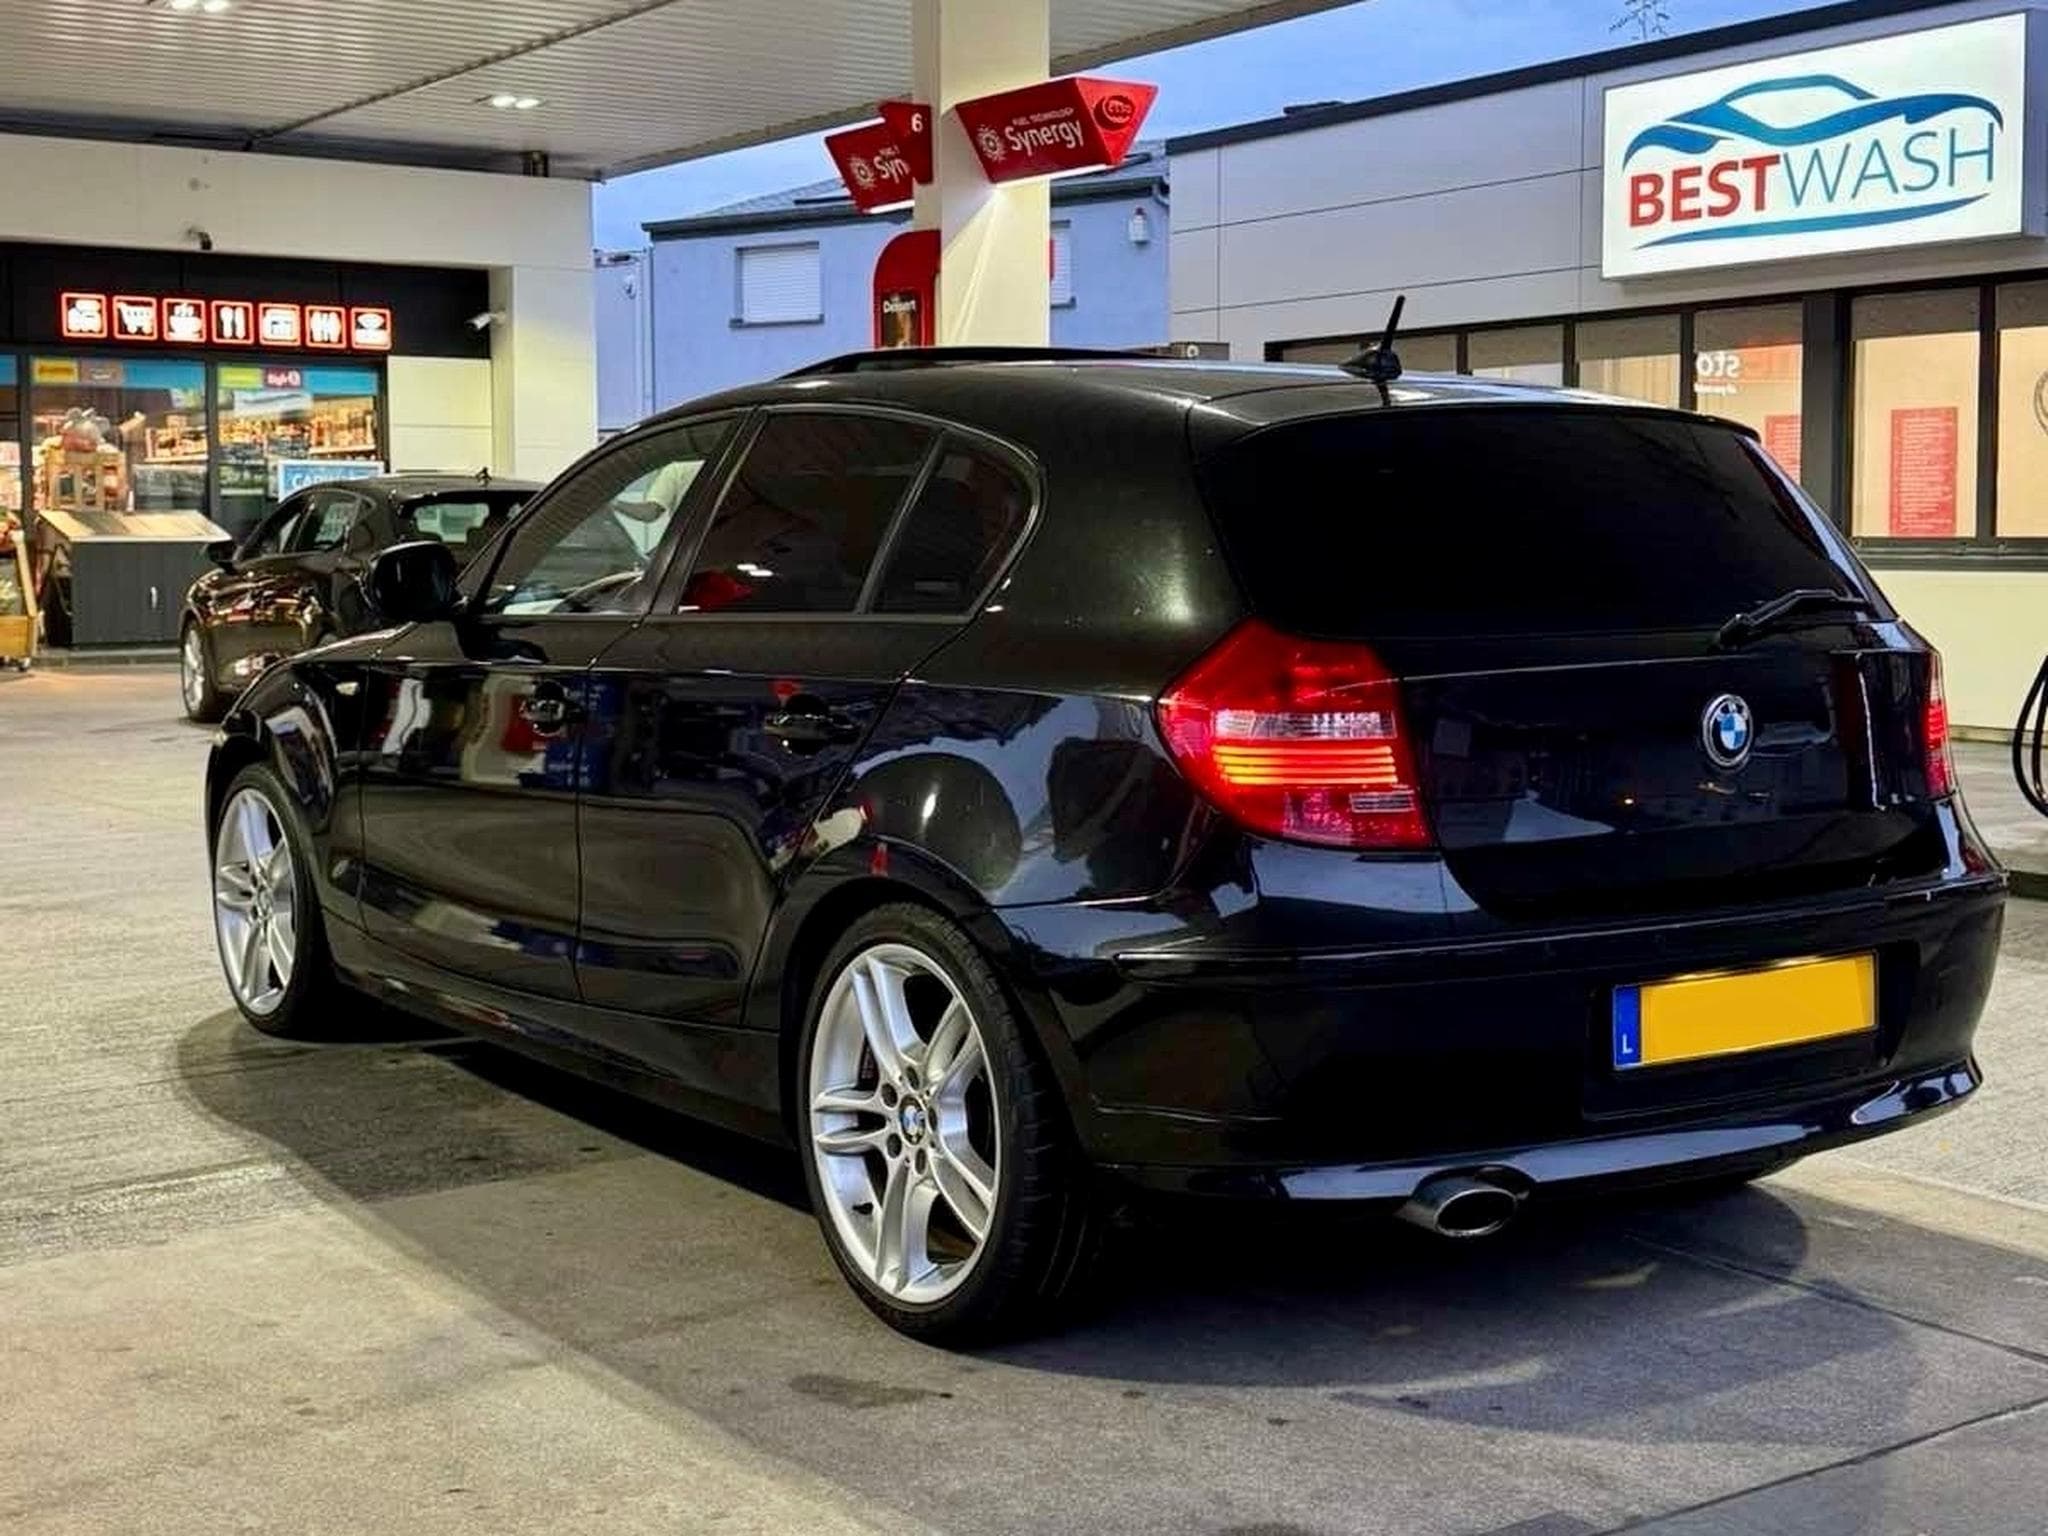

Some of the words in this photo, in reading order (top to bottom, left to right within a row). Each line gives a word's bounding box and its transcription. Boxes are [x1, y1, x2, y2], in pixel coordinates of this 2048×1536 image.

[911, 112, 923, 133] 6
[1004, 119, 1084, 157] Synergy
[1622, 1033, 1634, 1054] L
